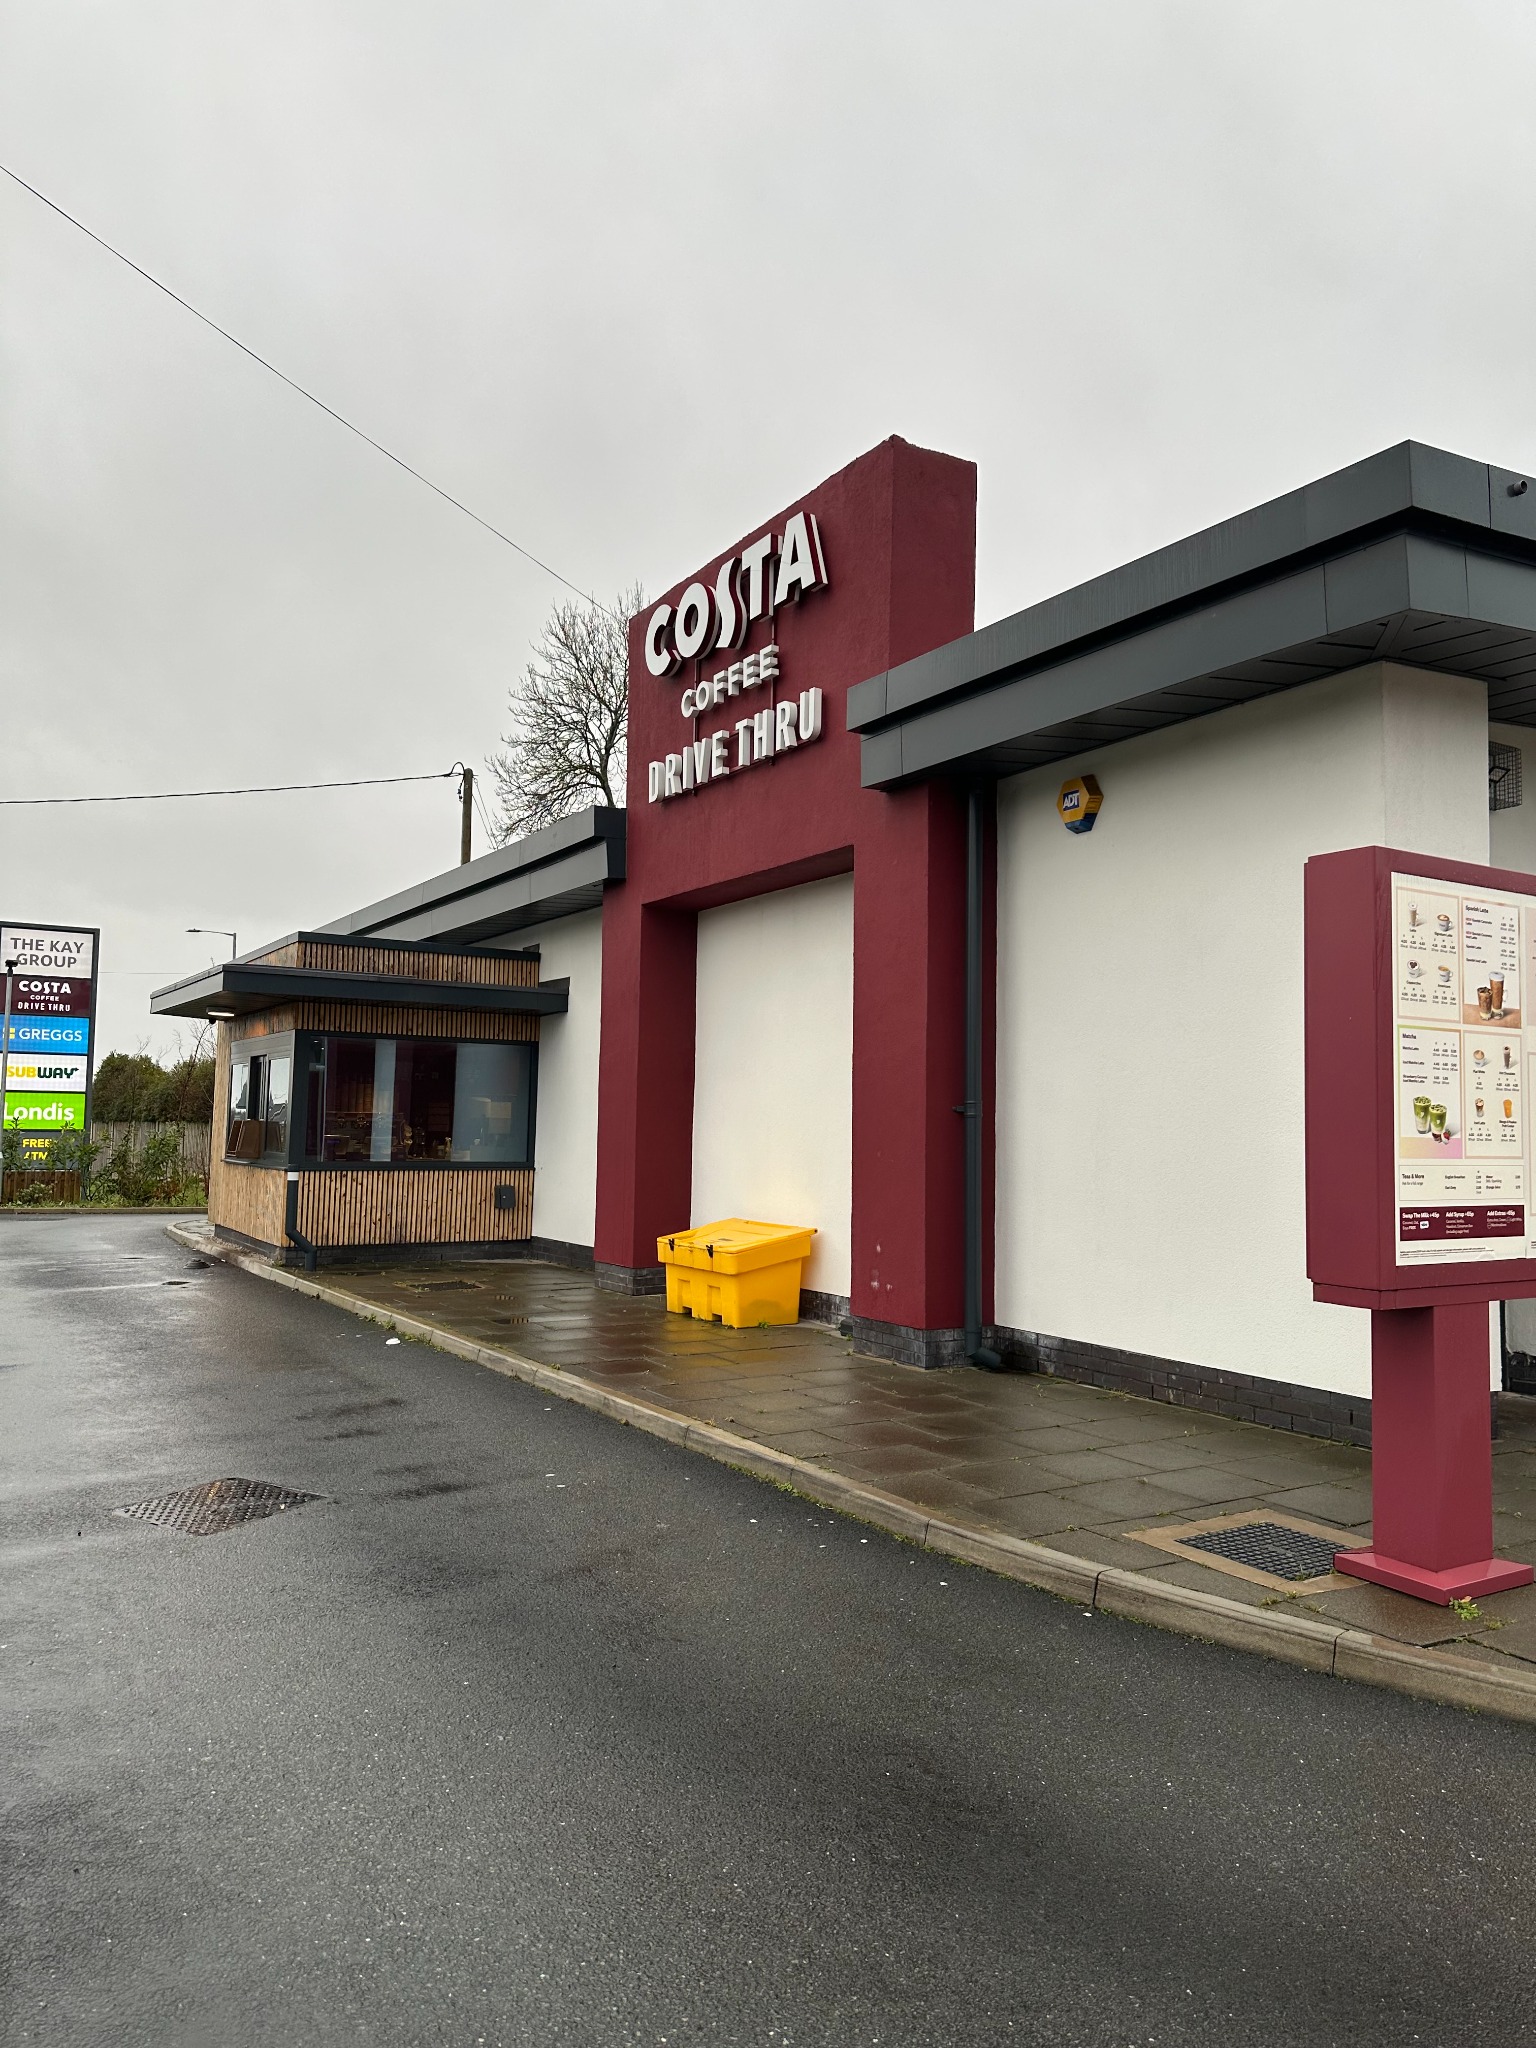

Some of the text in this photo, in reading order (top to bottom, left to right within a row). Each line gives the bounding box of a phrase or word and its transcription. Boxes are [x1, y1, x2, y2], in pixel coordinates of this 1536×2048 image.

[644, 511, 828, 677] COSTA
[681, 644, 779, 718] COFFEE
[648, 687, 822, 804] DRIVE THRU
[1063, 793, 1079, 809] ADT
[10, 937, 84, 954] THE KAY
[16, 953, 77, 968] GROUP
[19, 980, 71, 994] COSTA
[18, 1002, 71, 1011] DRIVE THRU
[19, 1028, 83, 1041] GREGGS
[6, 1066, 79, 1079] SUBWAY
[4, 1102, 75, 1121] Londis
